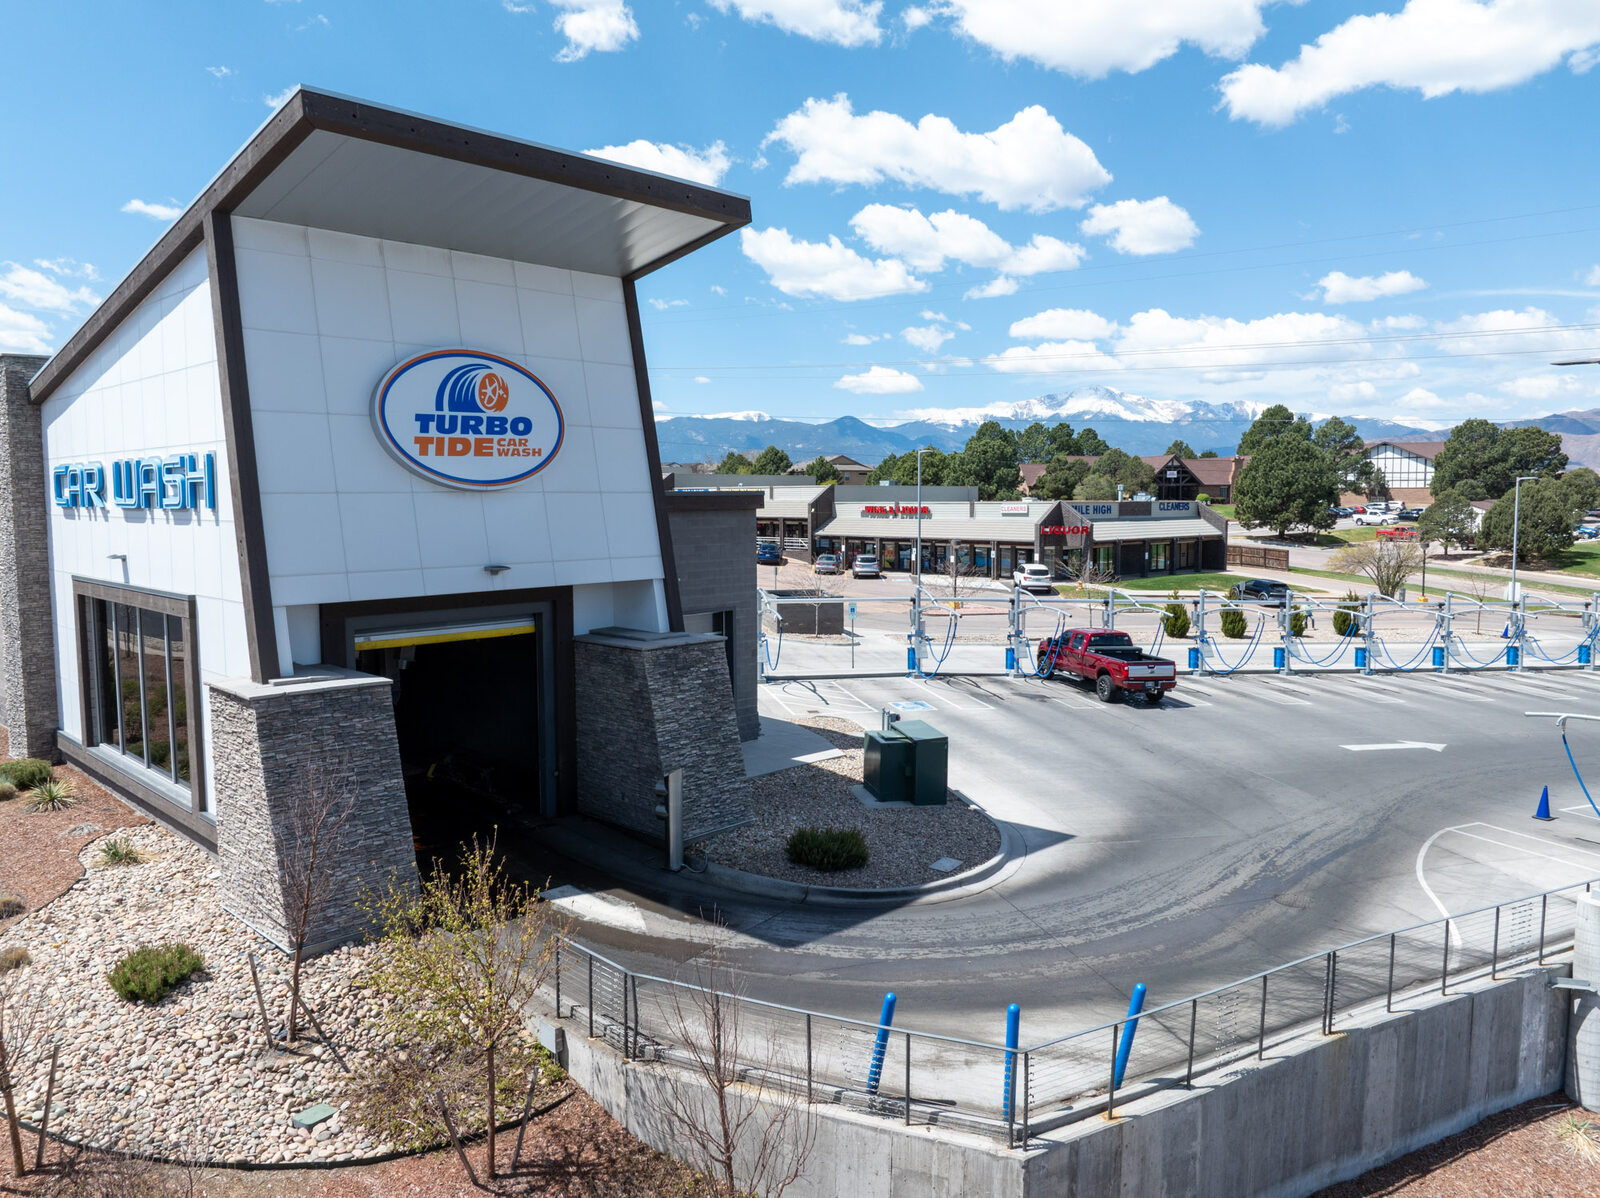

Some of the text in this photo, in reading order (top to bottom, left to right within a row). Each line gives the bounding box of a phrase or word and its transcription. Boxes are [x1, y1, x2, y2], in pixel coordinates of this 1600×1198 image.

[415, 414, 533, 436] TURBO
[414, 436, 494, 457] TIDE
[497, 438, 528, 447] CAR
[497, 448, 542, 457] WASH
[54, 452, 215, 510] CAR WASH
[1093, 505, 1112, 515] HIGH
[1159, 502, 1190, 511] CLEANERS
[1041, 526, 1089, 535] LIQUOR
